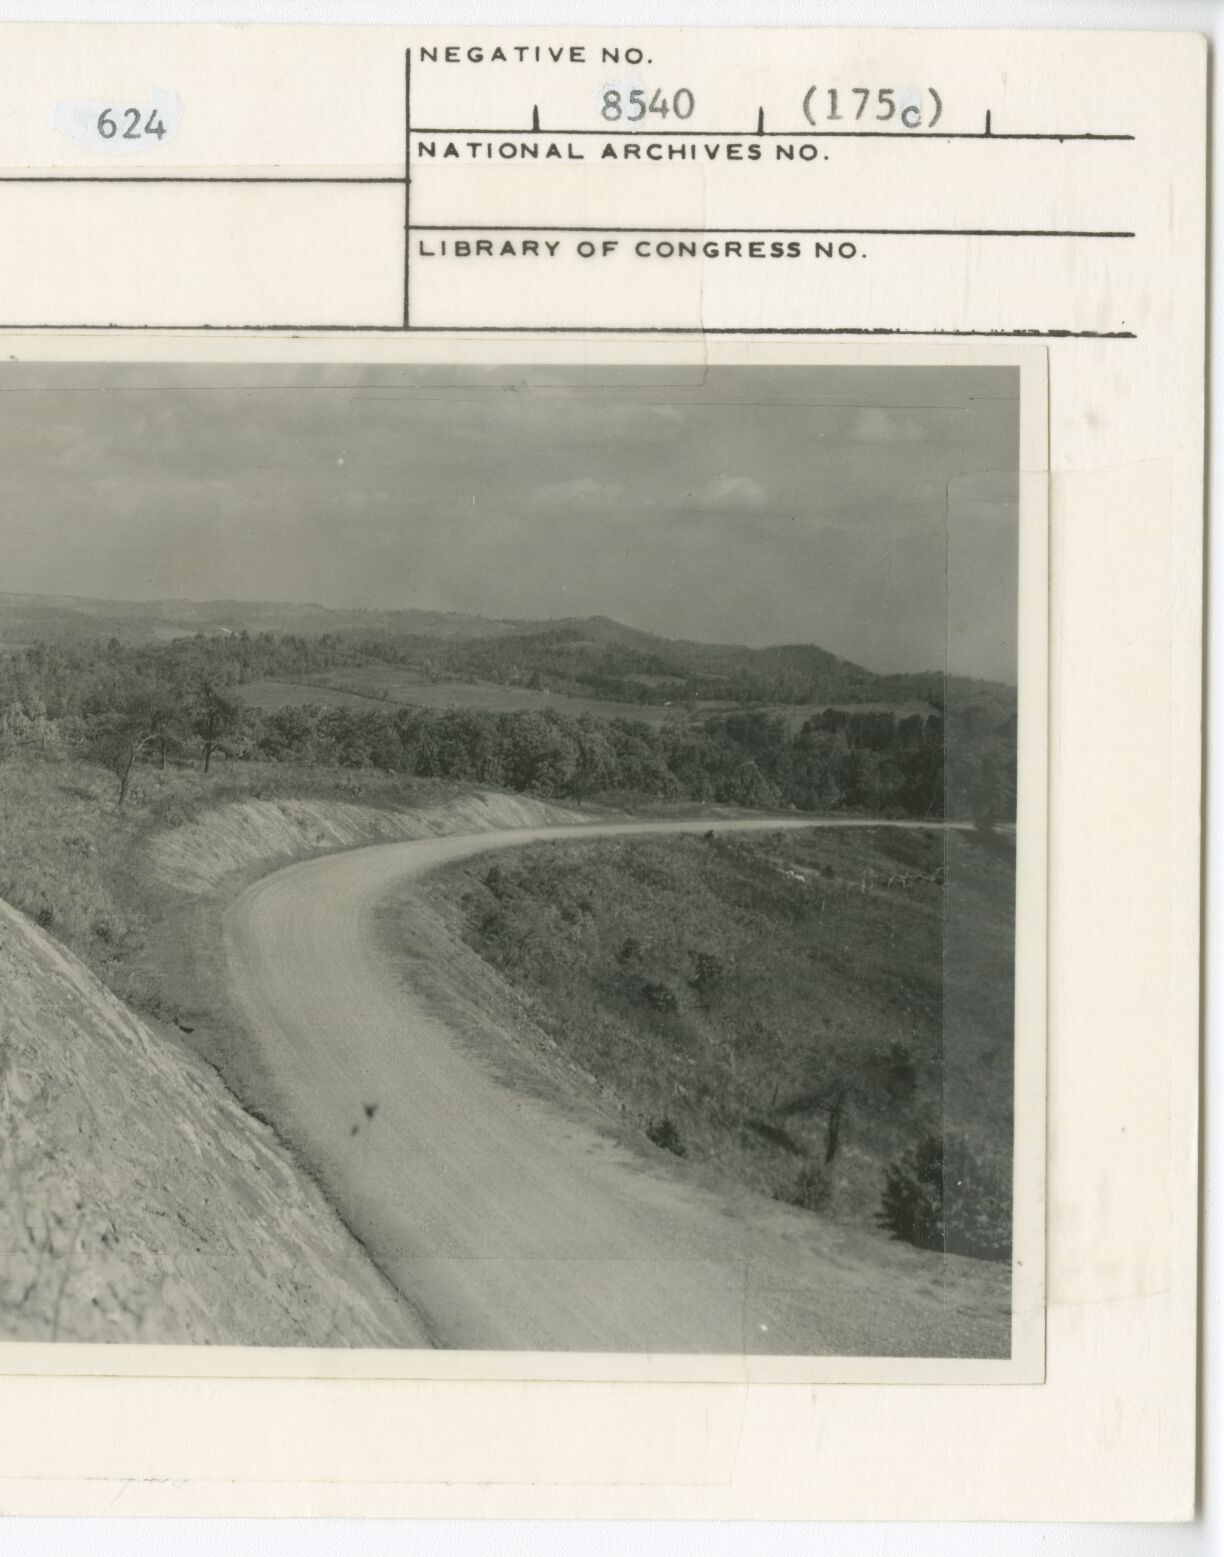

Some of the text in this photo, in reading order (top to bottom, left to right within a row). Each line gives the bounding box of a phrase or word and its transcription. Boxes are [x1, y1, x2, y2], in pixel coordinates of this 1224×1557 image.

[419, 45, 654, 66] NEGATIVE NO.
[600, 84, 943, 130] 8540 (175c)
[96, 107, 167, 141] 624
[417, 140, 830, 163] NATIONAL ARCHIVES NO.
[418, 238, 868, 260] LIBRARY OF CONGRESS NO.
